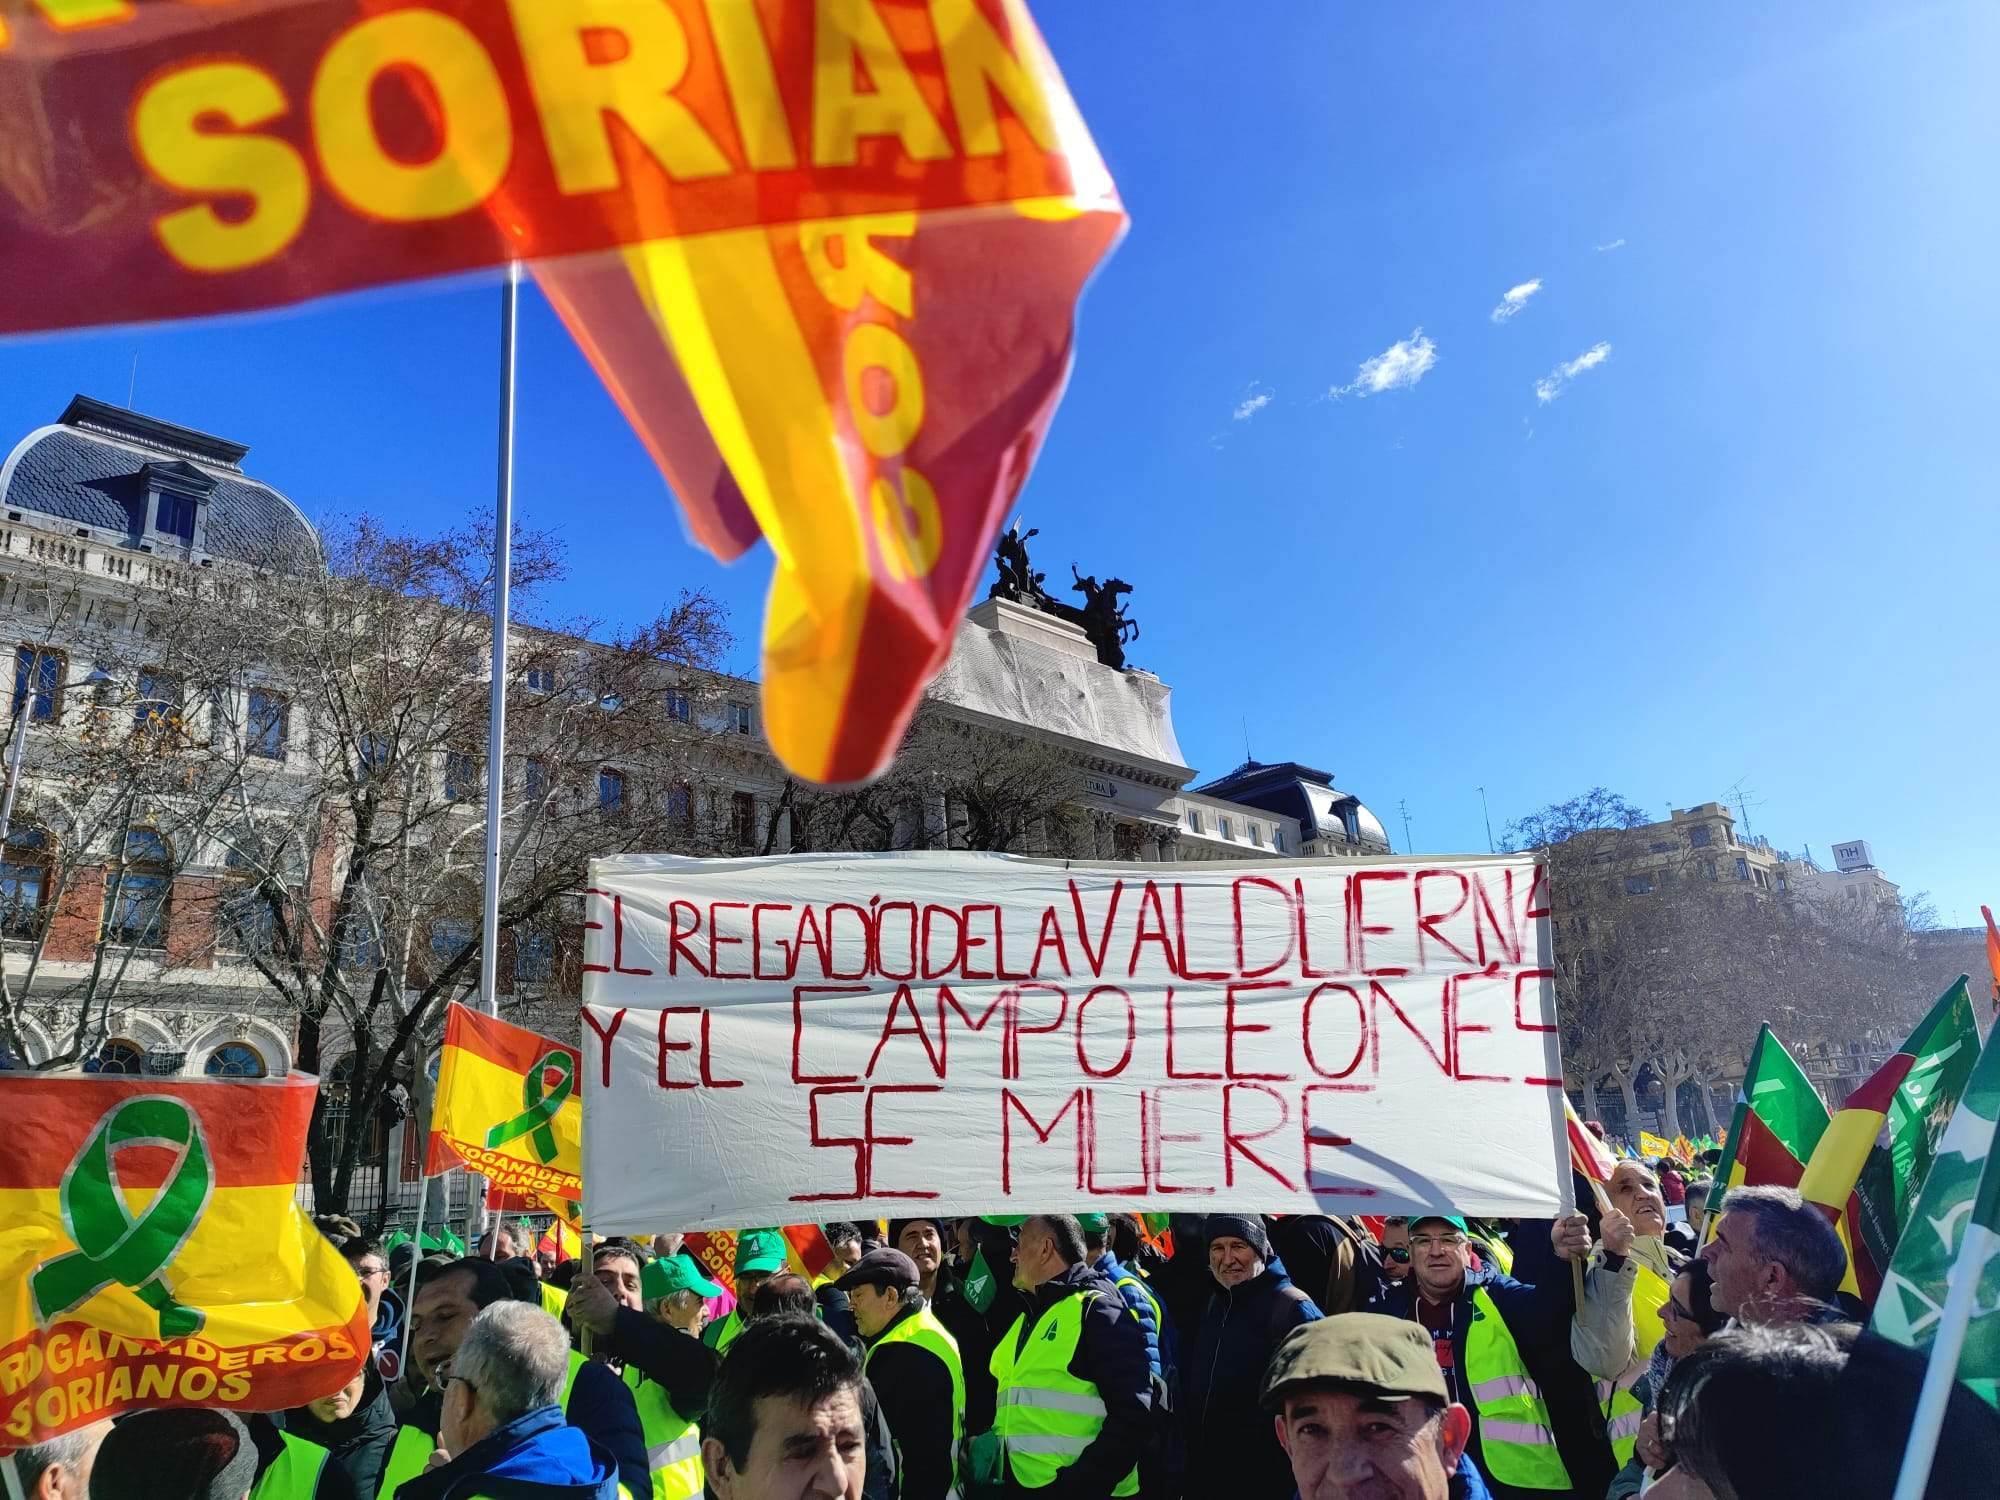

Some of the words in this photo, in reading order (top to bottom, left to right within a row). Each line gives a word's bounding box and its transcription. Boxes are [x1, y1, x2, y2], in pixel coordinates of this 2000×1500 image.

[581, 1006, 627, 1088] Y
[657, 1006, 744, 1088] EL
[791, 983, 1135, 1084] CAMPO
[788, 1084, 945, 1201] SE
[1002, 1081, 1377, 1196] MUERE
[5, 1365, 253, 1438] SORIANOS
